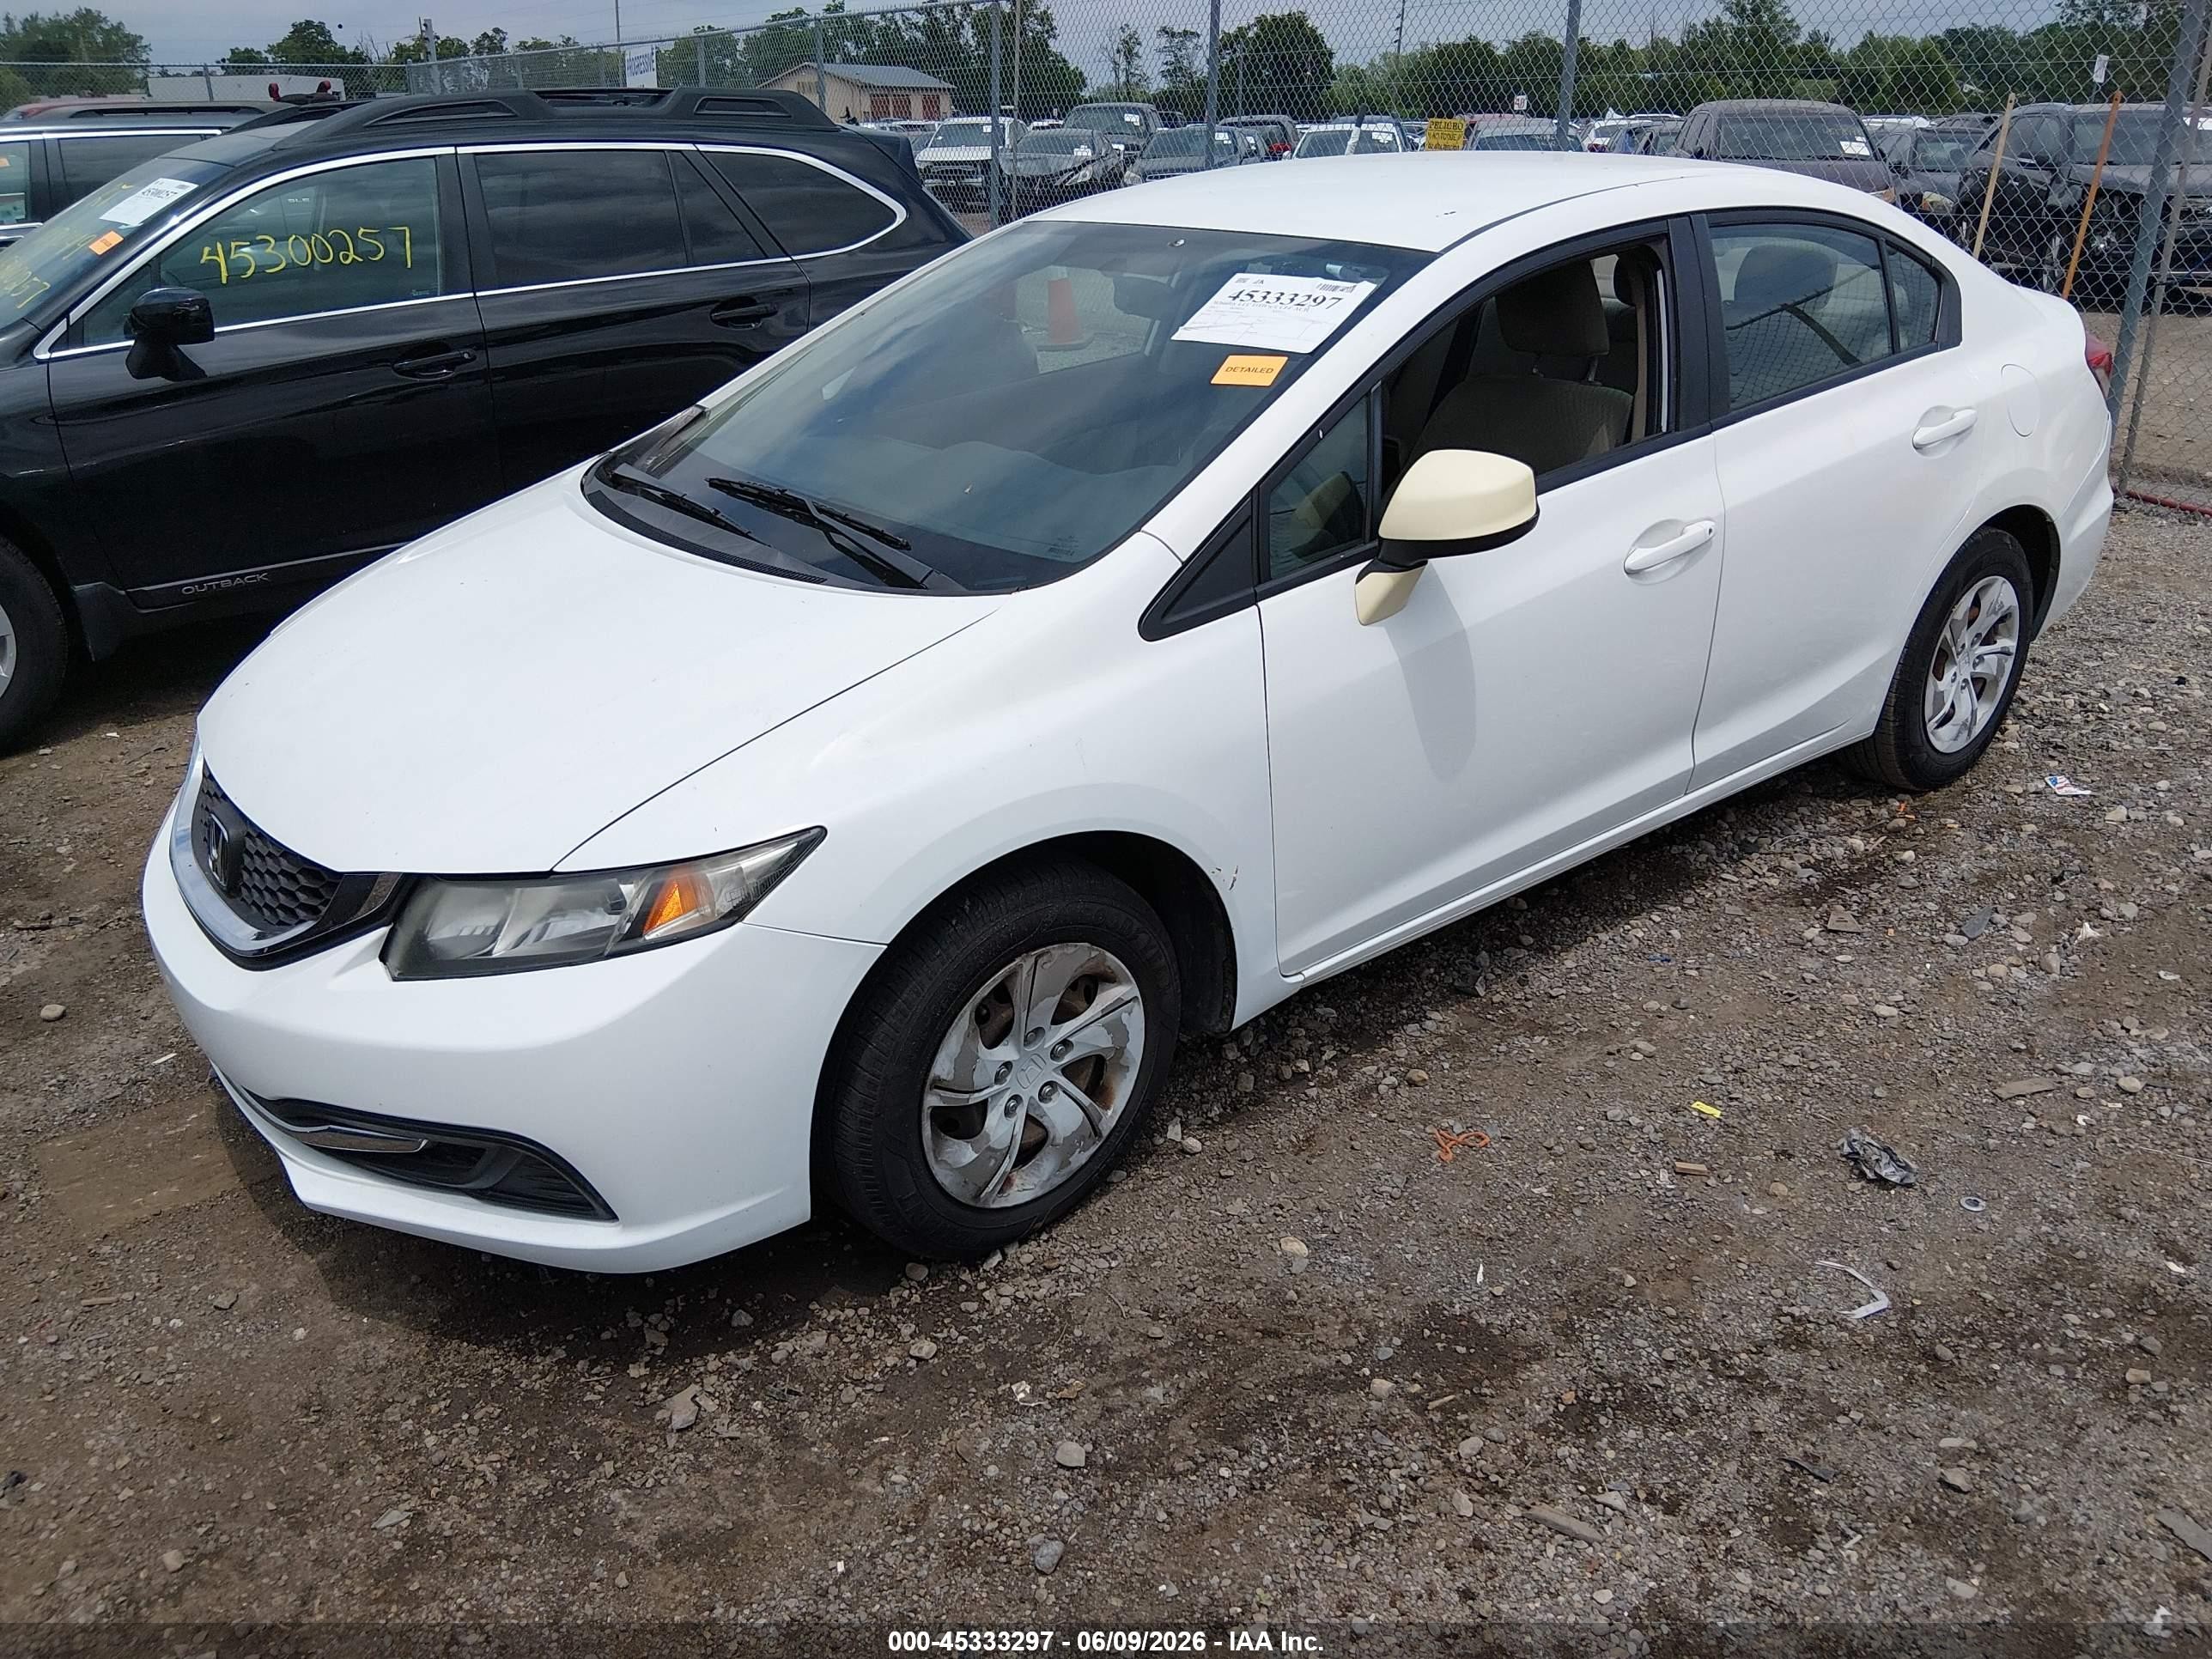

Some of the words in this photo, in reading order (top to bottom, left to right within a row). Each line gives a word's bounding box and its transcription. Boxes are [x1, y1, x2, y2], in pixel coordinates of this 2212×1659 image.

[200, 227, 411, 284] 45300257
[1227, 289, 1344, 310] 45333297
[1224, 365, 1274, 374] DETAILED
[181, 572, 269, 594] OUTBACK
